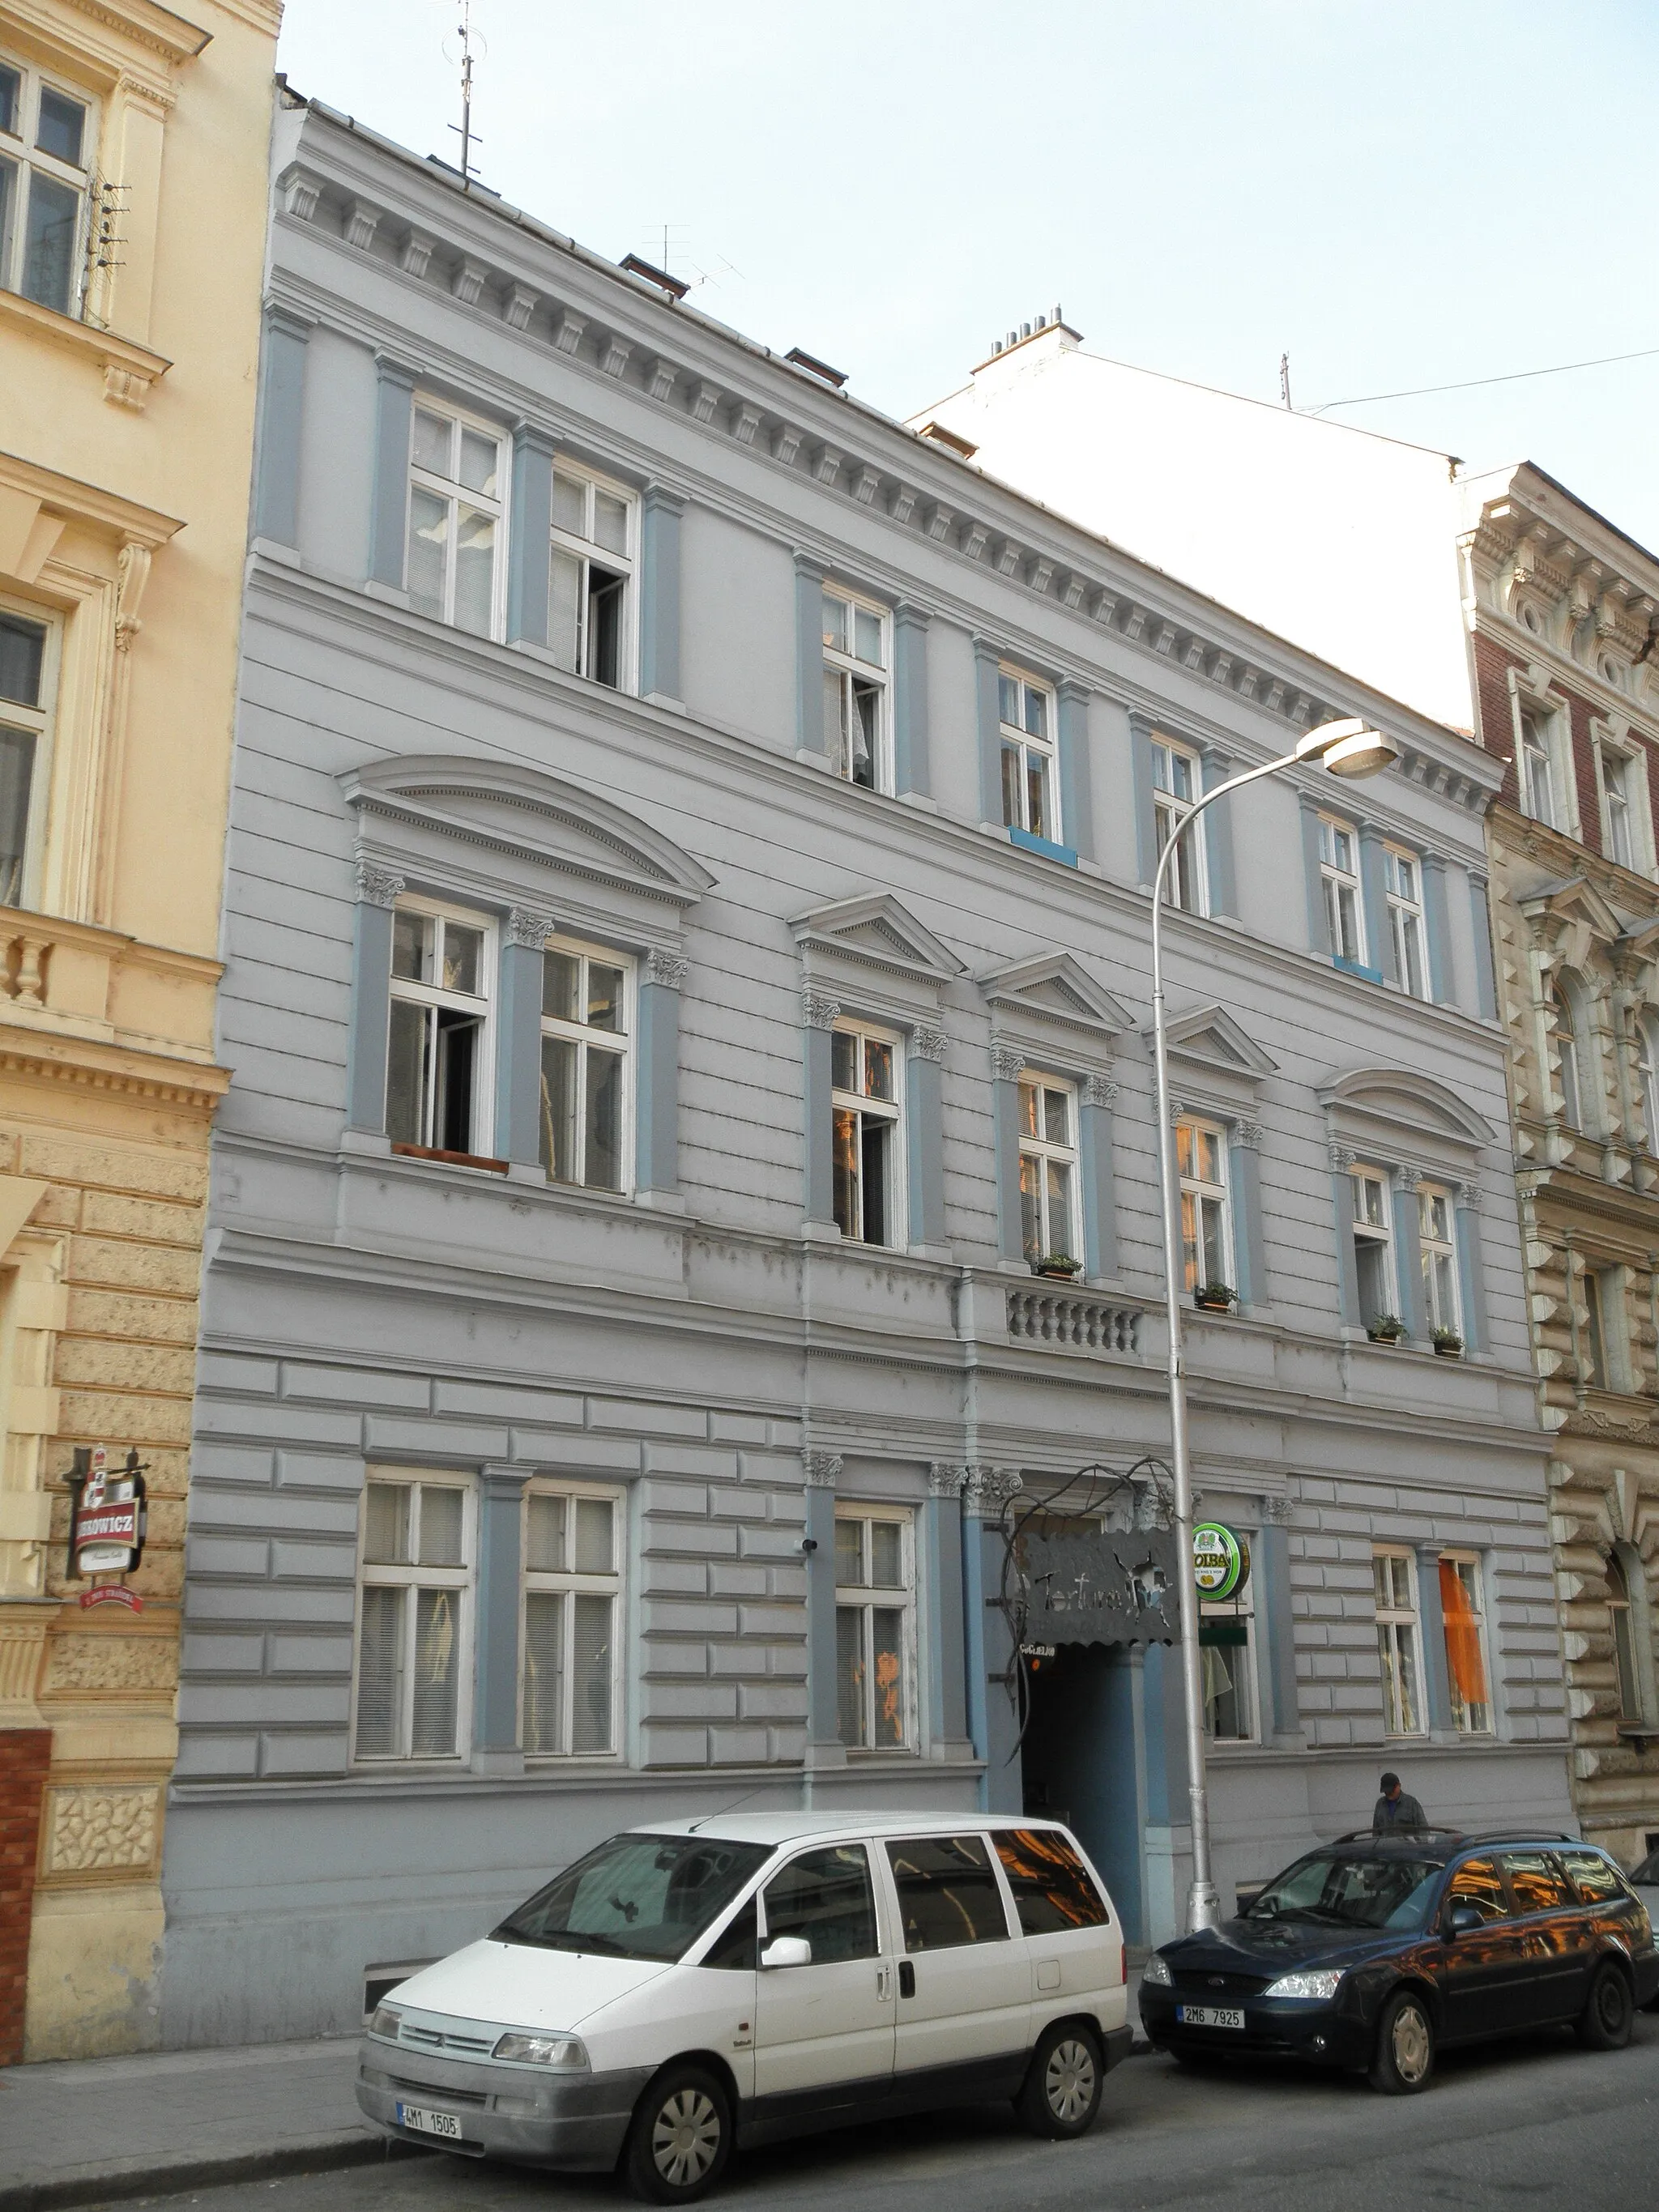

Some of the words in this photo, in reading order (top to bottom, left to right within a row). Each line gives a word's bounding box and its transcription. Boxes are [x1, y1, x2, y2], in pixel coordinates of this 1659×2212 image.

[1193, 1553, 1230, 1569] OLBA
[1185, 2009, 1205, 2022] 2M6
[1213, 2010, 1239, 2025] 7925
[406, 2108, 423, 2129] 4M1
[430, 2114, 457, 2135] 1505
